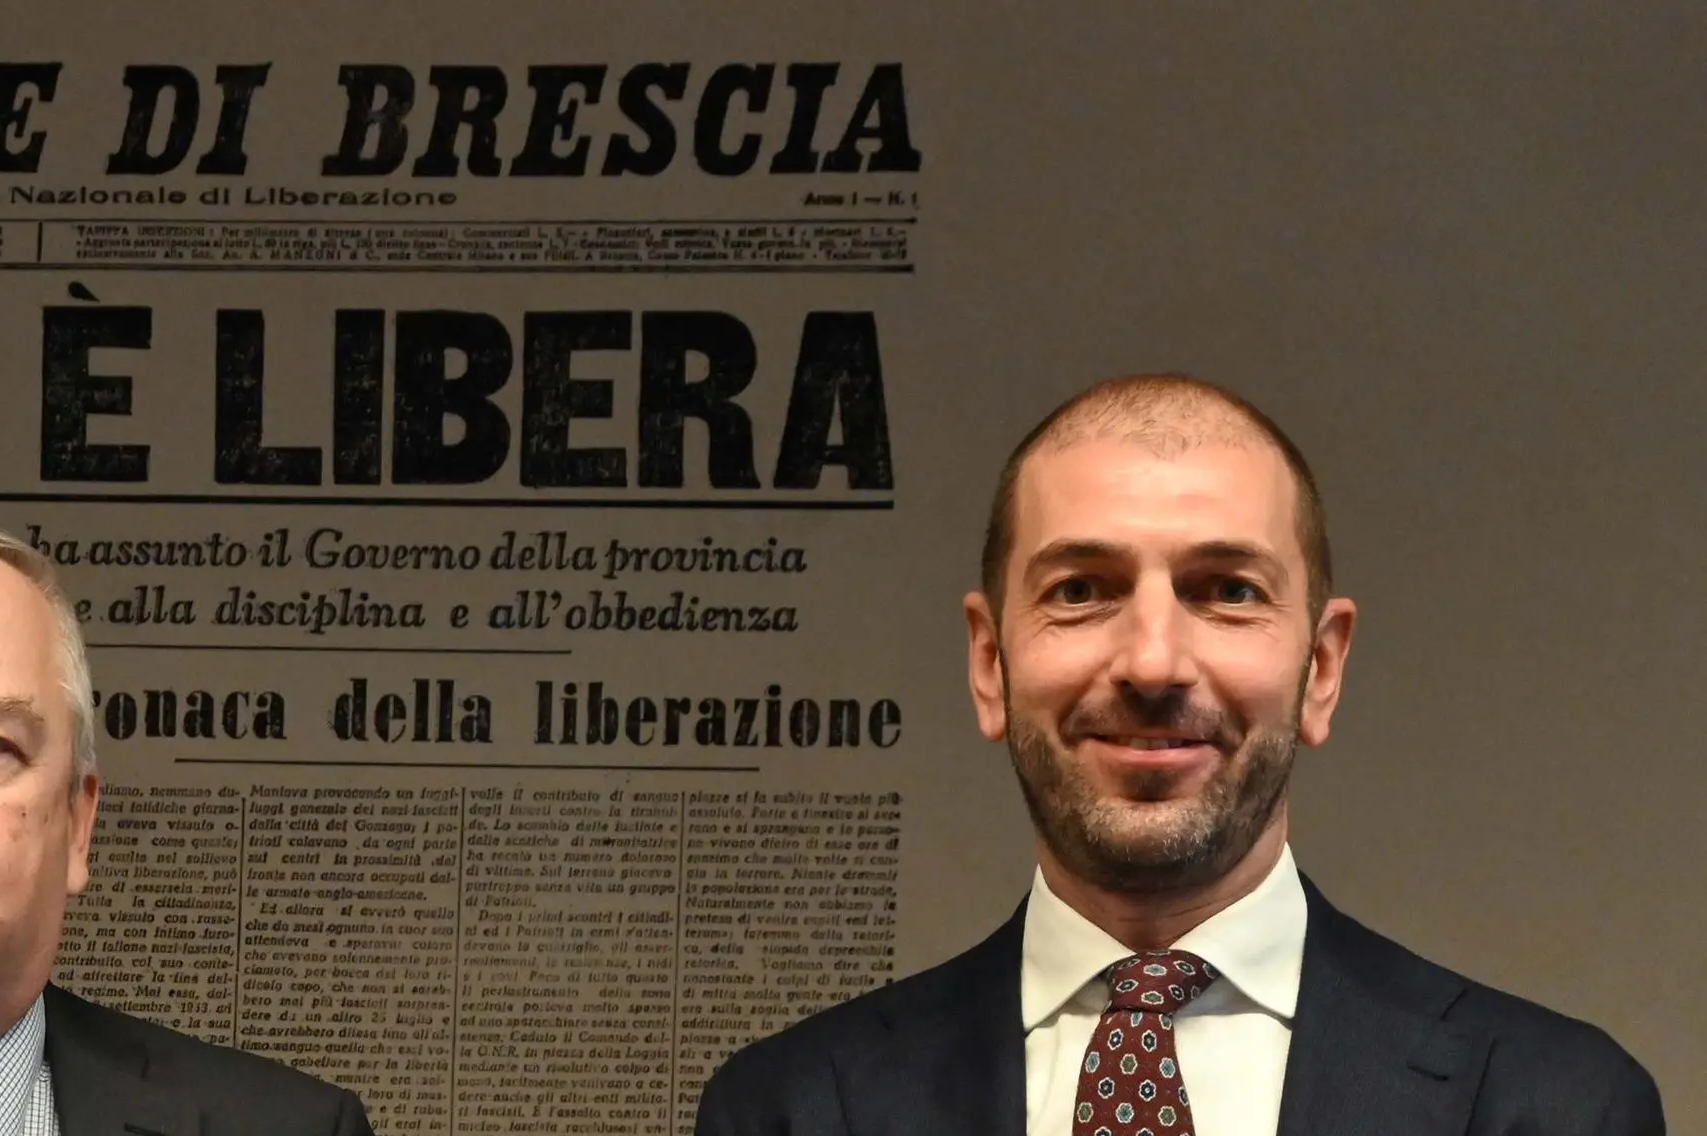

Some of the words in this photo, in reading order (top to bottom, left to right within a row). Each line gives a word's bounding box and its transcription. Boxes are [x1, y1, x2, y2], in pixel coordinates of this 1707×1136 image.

[106, 61, 272, 176] DI
[321, 61, 924, 177] BRESCIA
[10, 186, 186, 205] Nazionale
[200, 187, 230, 205] di
[245, 187, 458, 206] Liberazione
[41, 280, 153, 482] È
[213, 308, 896, 490] LIBERA
[27, 523, 82, 567] ha
[89, 535, 248, 571] assunto
[261, 530, 292, 569] il
[306, 529, 482, 572] Governo
[490, 531, 596, 573] della
[603, 537, 808, 578] provincia
[108, 587, 195, 627] alla
[215, 589, 425, 636] disciplina
[451, 608, 470, 630] e
[490, 591, 799, 635] all'obbedienza
[92, 690, 289, 743] onaca
[331, 677, 494, 746] della
[535, 680, 904, 751] liberazione
